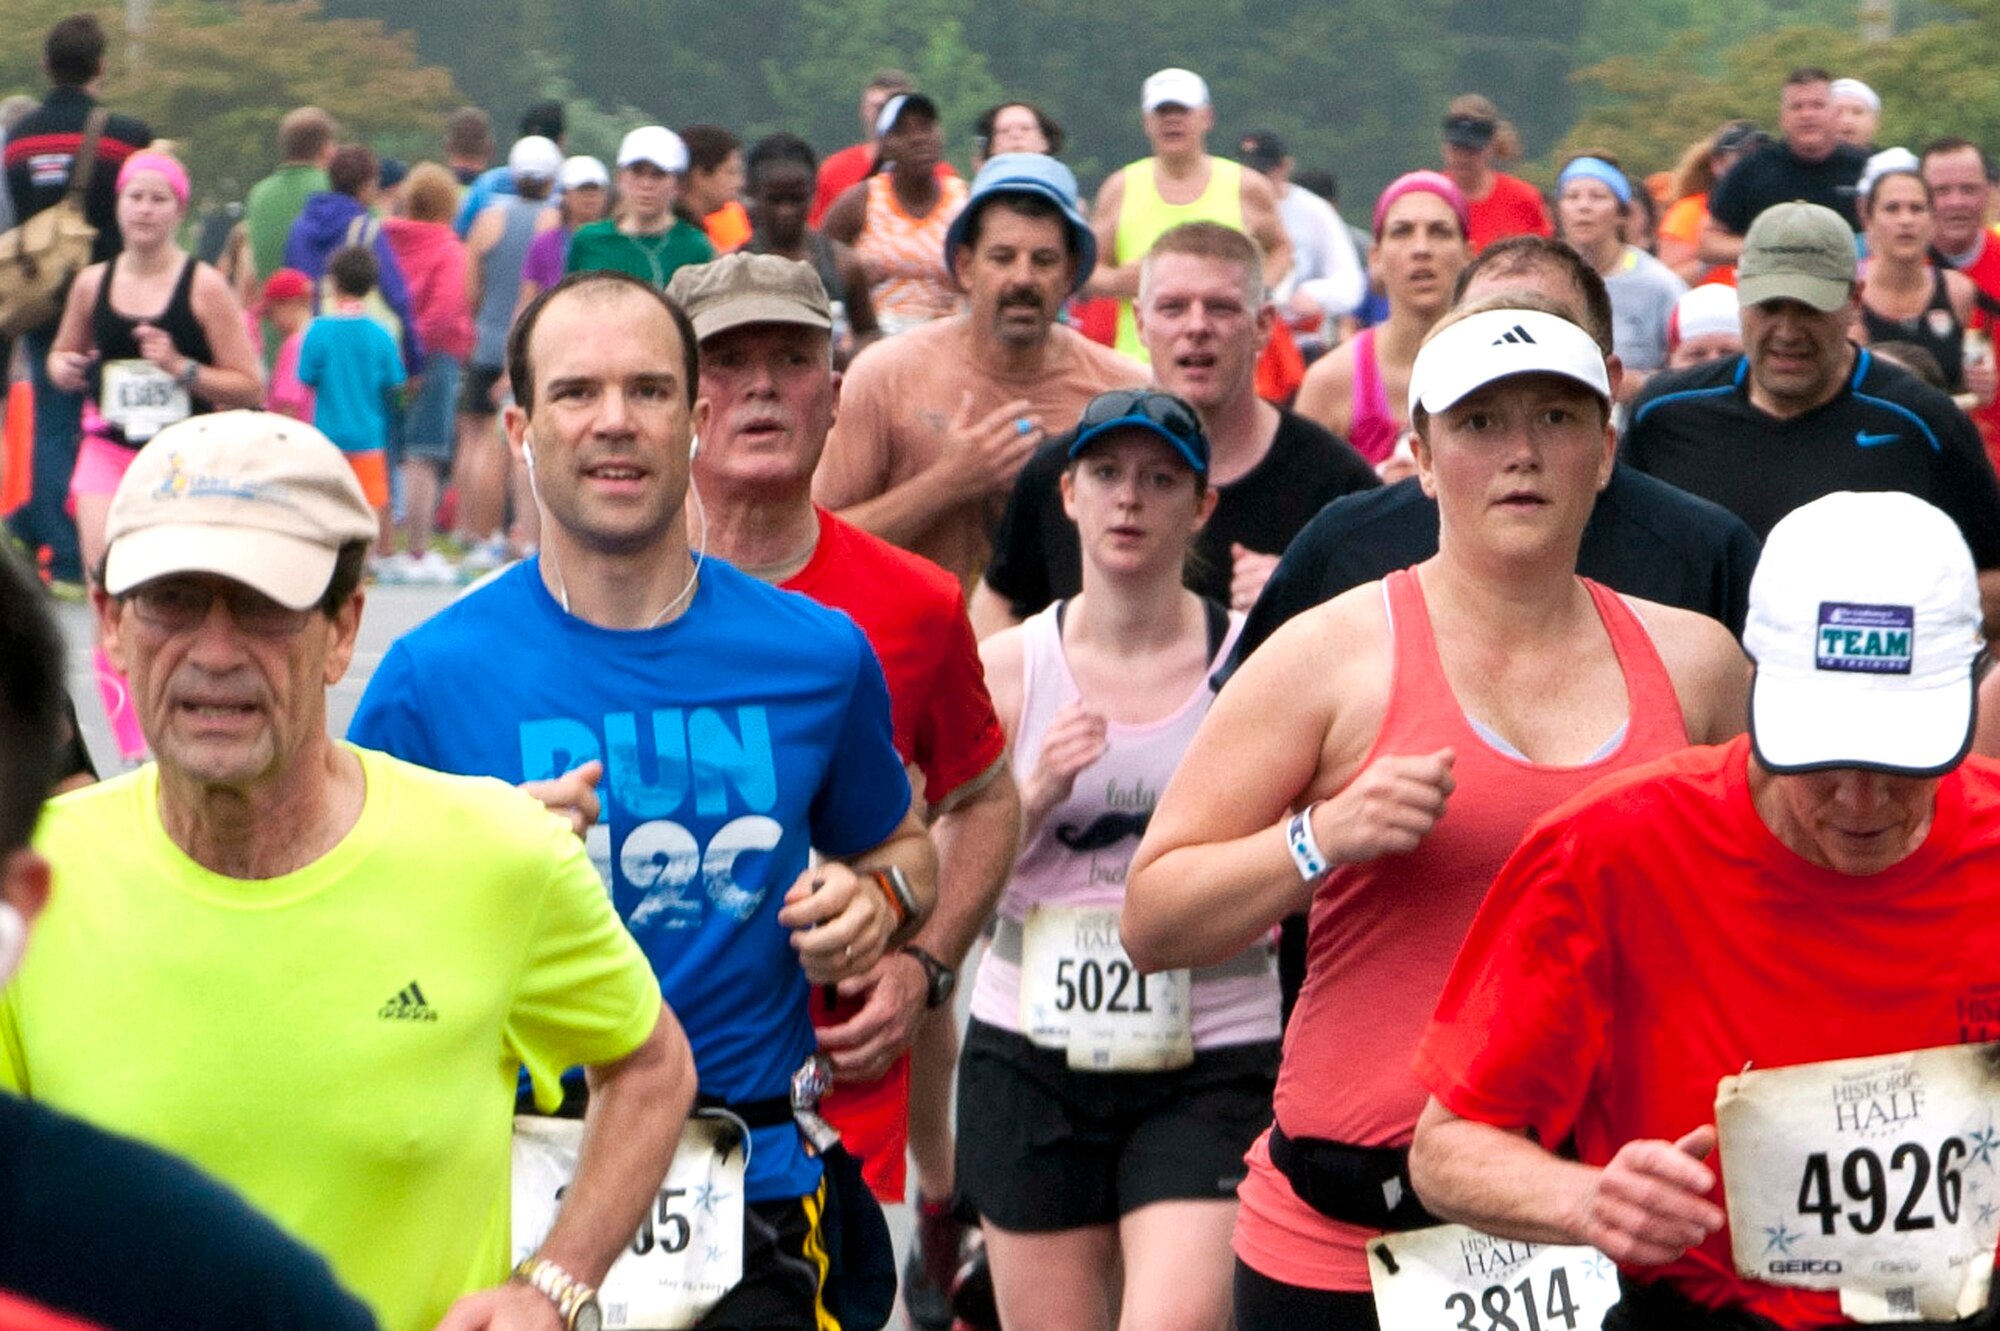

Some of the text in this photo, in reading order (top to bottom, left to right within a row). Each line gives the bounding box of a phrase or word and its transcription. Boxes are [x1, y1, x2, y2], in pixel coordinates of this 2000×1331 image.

[1823, 629, 1908, 657] TEAM
[519, 704, 778, 821] RUN
[1055, 957, 1153, 1014] 5021
[1836, 1090, 1926, 1131] HALF
[1797, 1136, 1967, 1236] 4926
[1768, 1258, 1843, 1275] GEICO
[1445, 1266, 1580, 1331] 3814
